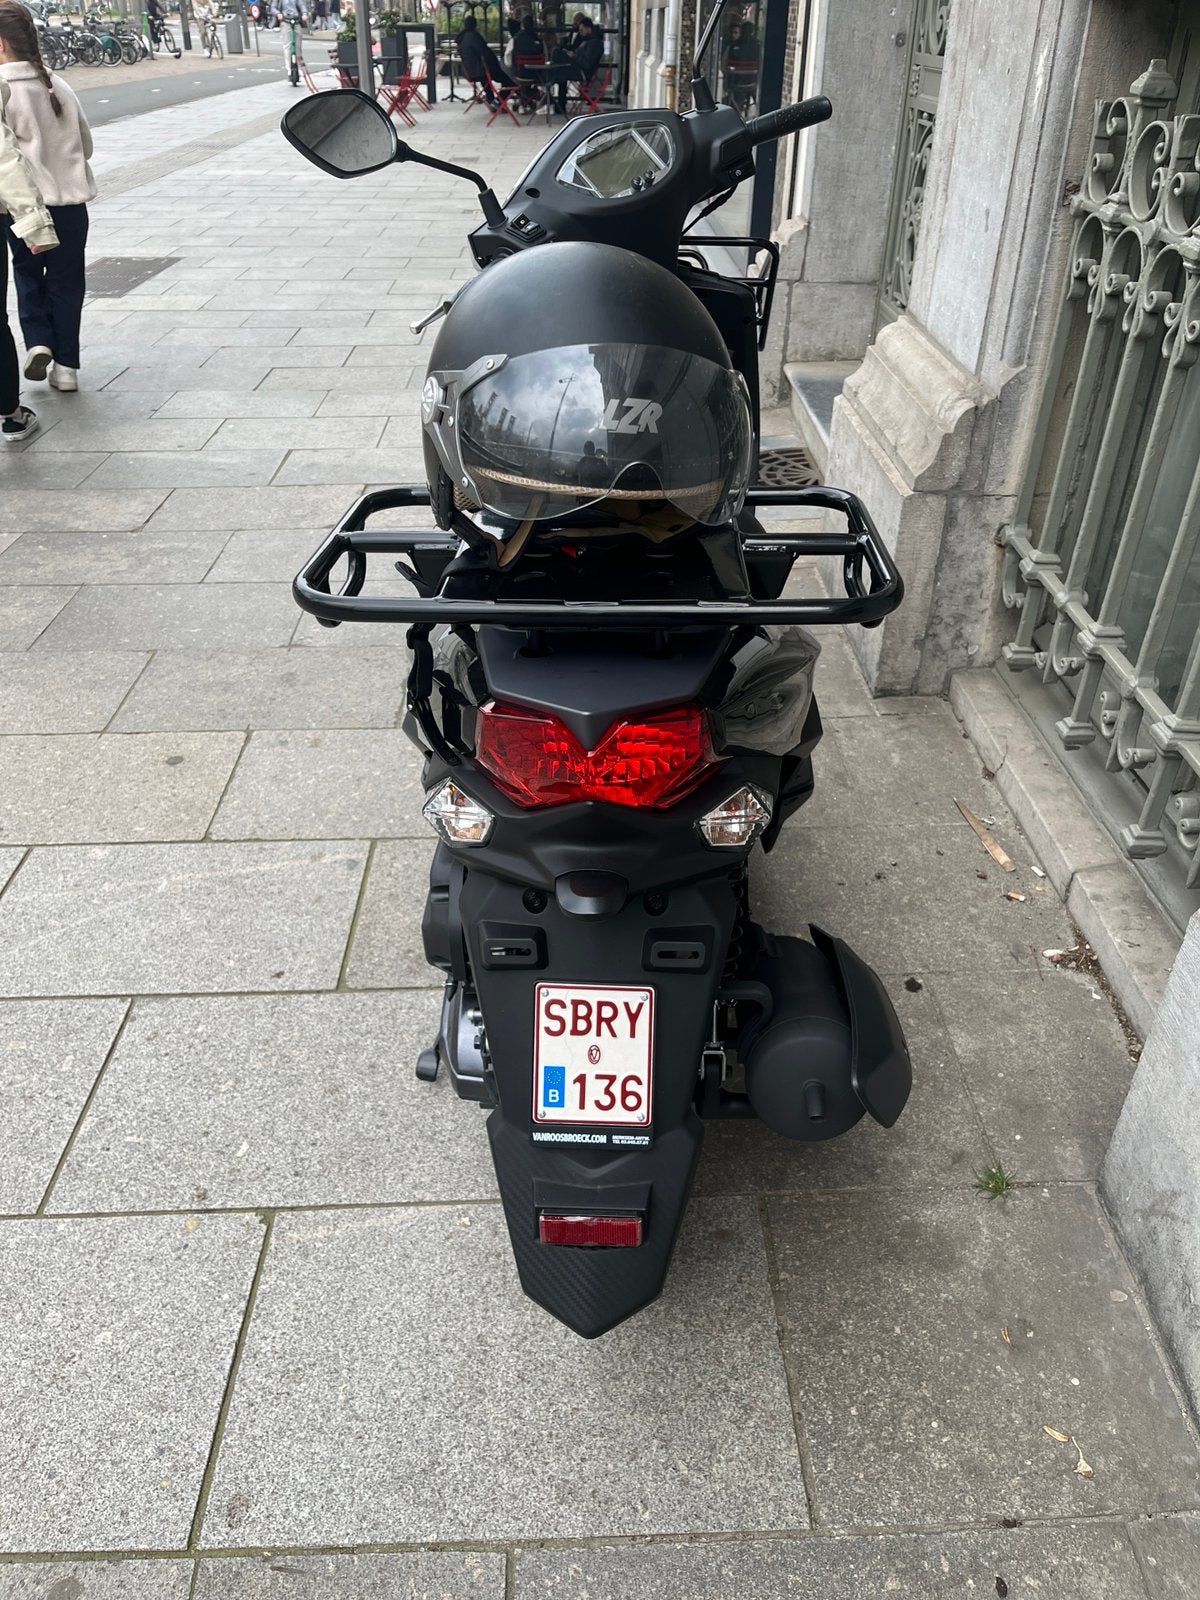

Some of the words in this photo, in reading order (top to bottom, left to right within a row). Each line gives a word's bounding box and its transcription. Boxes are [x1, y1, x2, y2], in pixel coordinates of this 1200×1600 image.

[599, 397, 663, 435] LZR
[543, 998, 645, 1039] SBRY
[548, 1089, 560, 1103] B
[572, 1073, 643, 1112] 136
[532, 1132, 607, 1144] VANROOSBROECK.COM
